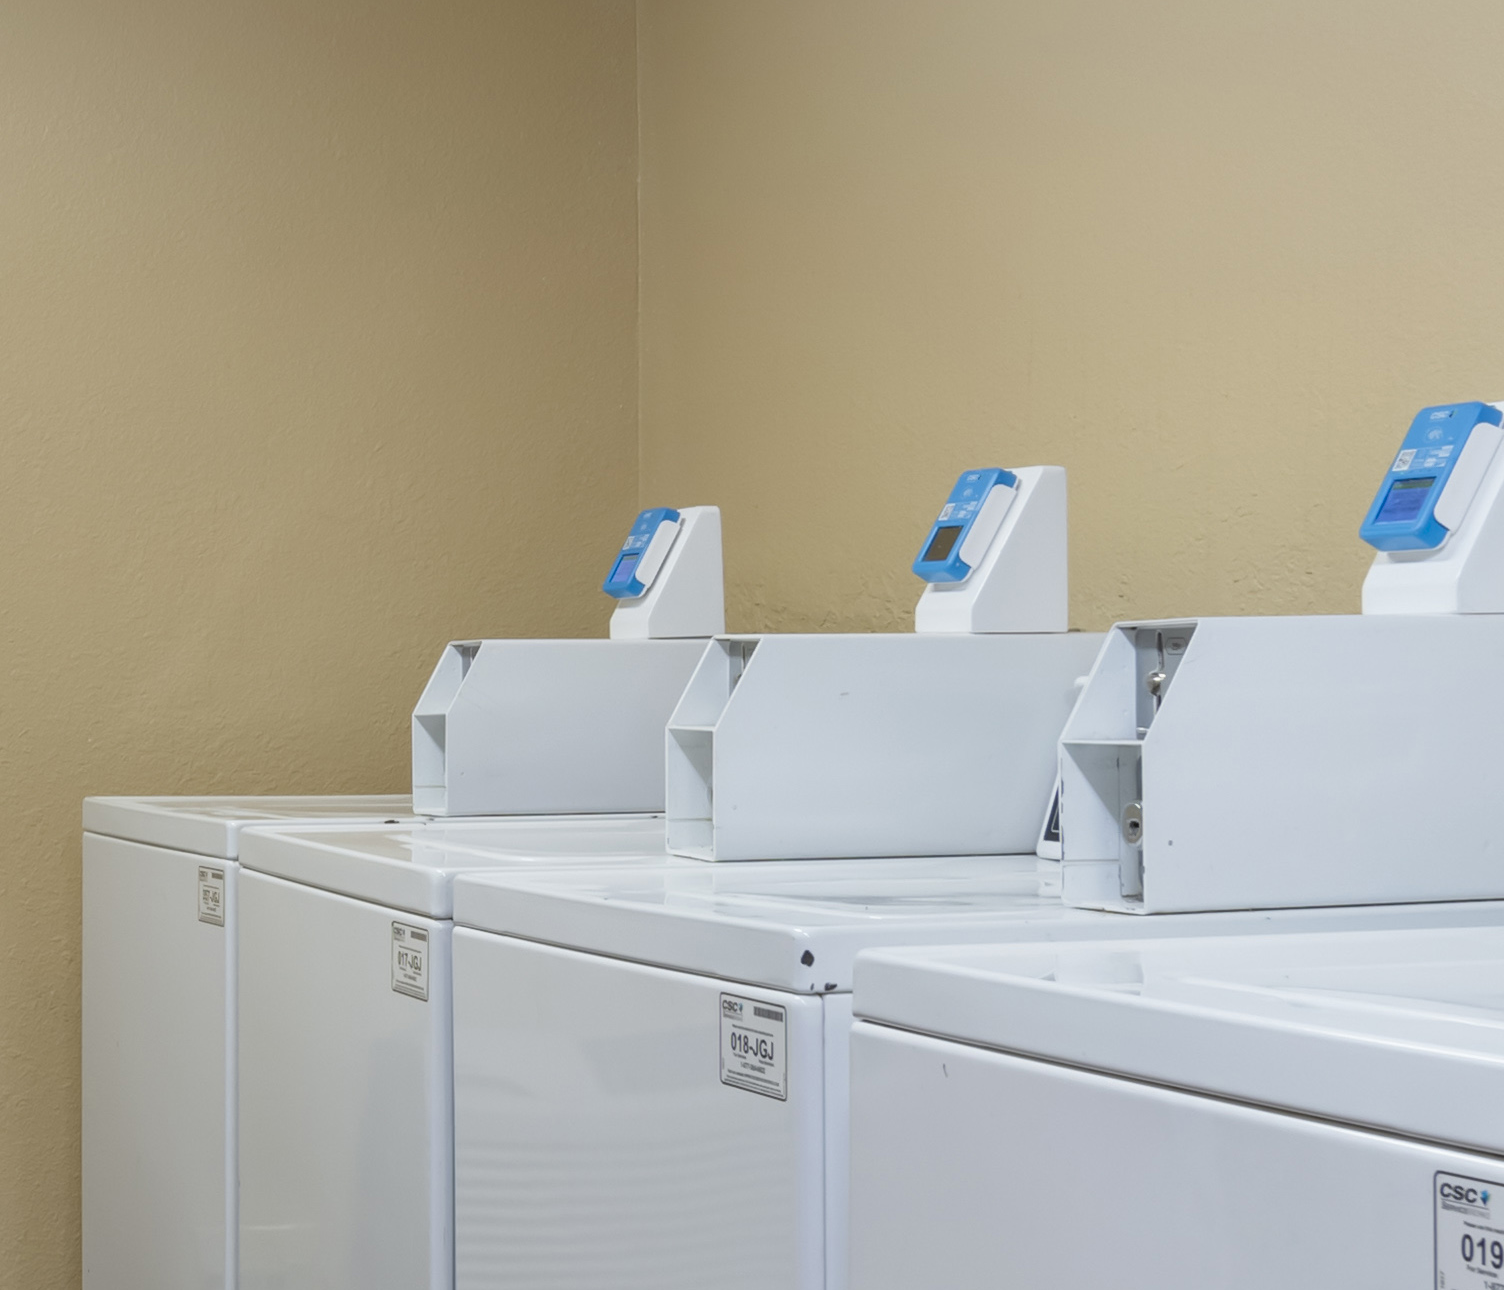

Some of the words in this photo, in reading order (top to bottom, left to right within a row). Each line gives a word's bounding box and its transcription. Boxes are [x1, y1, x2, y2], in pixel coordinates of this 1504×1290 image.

[398, 951, 422, 971] 017-JGJ
[722, 999, 738, 1012] CSC
[730, 1032, 774, 1060] 018-JGJ
[1440, 1183, 1478, 1203] CSC
